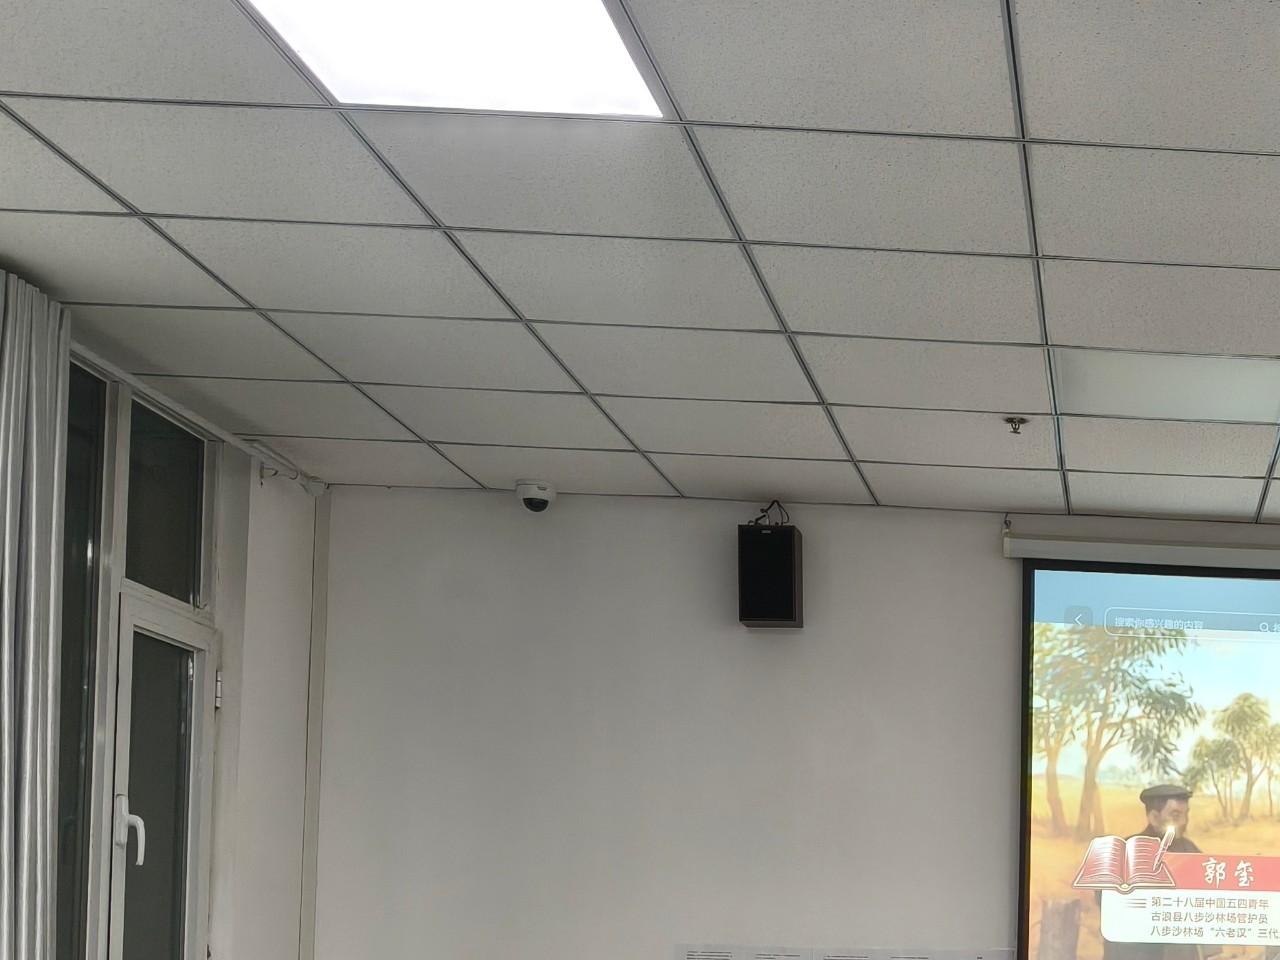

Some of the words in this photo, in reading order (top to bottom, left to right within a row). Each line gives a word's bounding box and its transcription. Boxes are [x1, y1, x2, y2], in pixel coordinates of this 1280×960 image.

[1151, 896, 1269, 910] 第二十八届中国五四青年
[1151, 911, 1268, 925] 古浪县八步沙林场管护员
